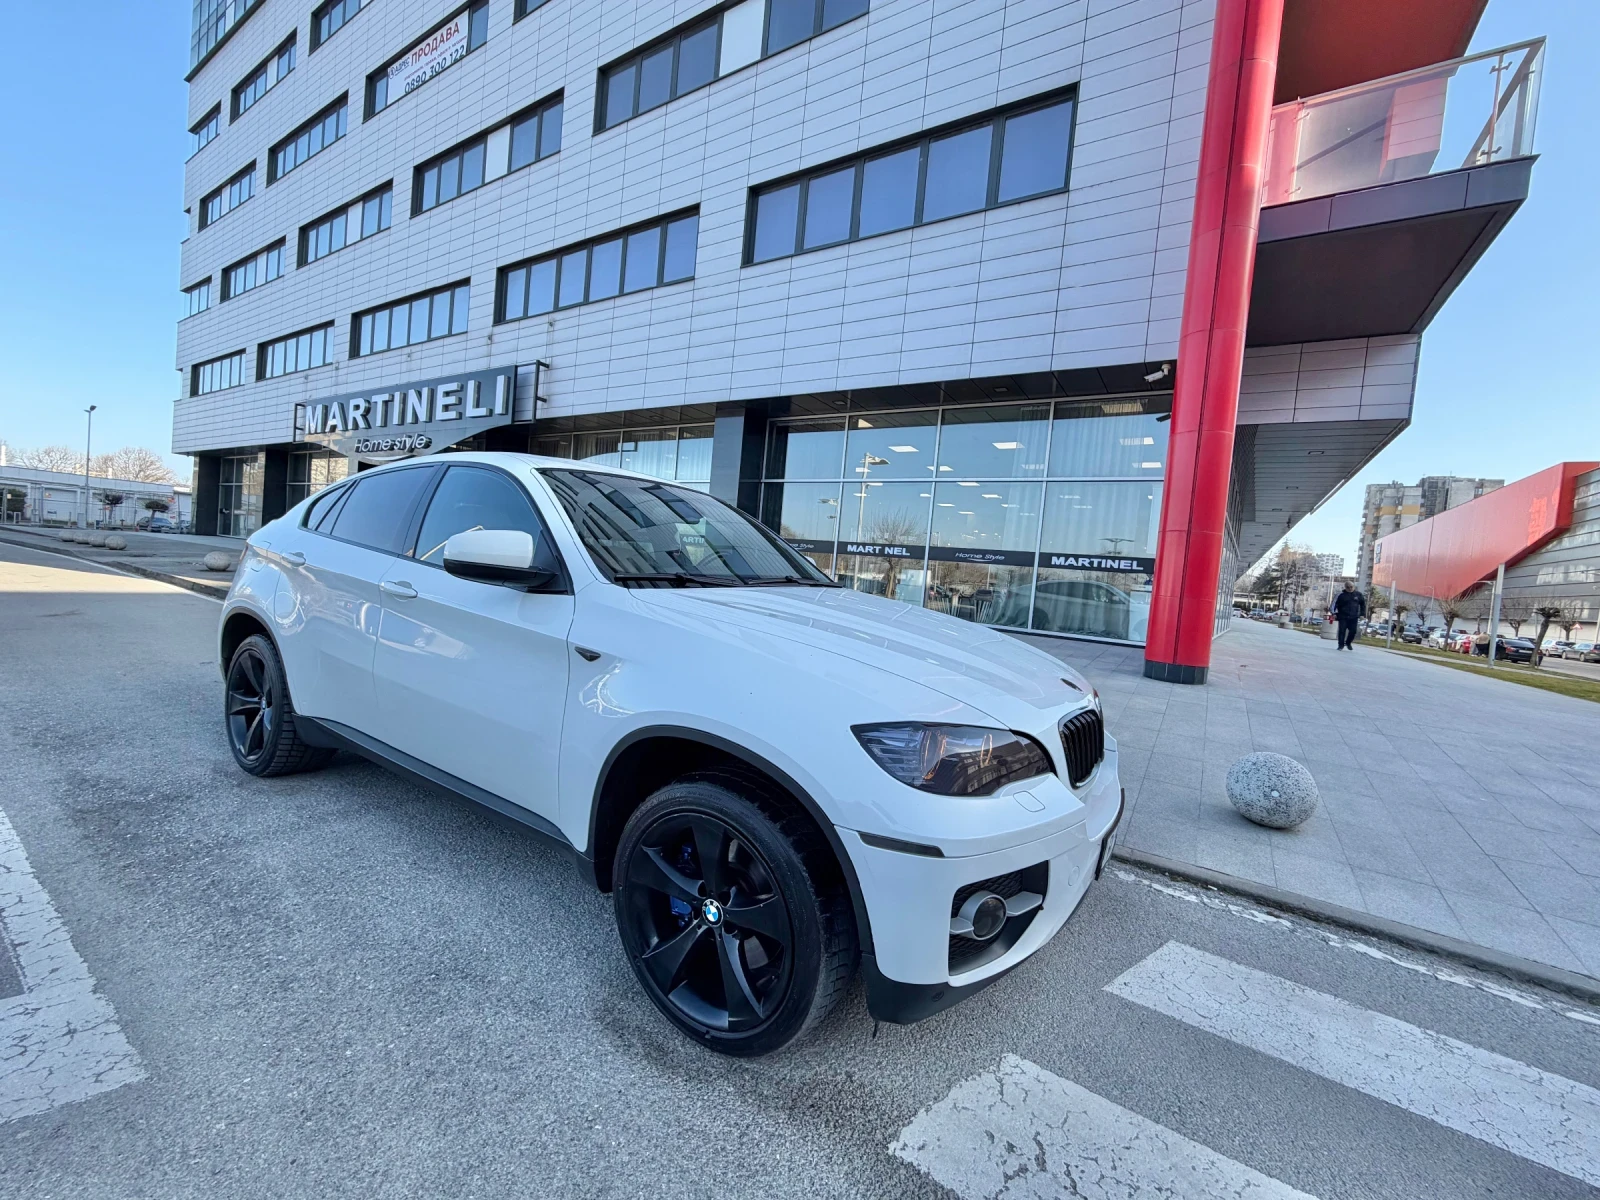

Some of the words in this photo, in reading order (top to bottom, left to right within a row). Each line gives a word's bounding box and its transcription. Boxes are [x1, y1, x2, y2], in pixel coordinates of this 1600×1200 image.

[411, 22, 460, 66] ПРОДАВА
[404, 71, 427, 94] 0890
[429, 57, 447, 78] 300
[450, 44, 465, 63] 122
[305, 374, 512, 434] MARTINELI
[354, 438, 392, 453] Home
[393, 433, 429, 453] style
[1051, 556, 1144, 571] MARTINEL
